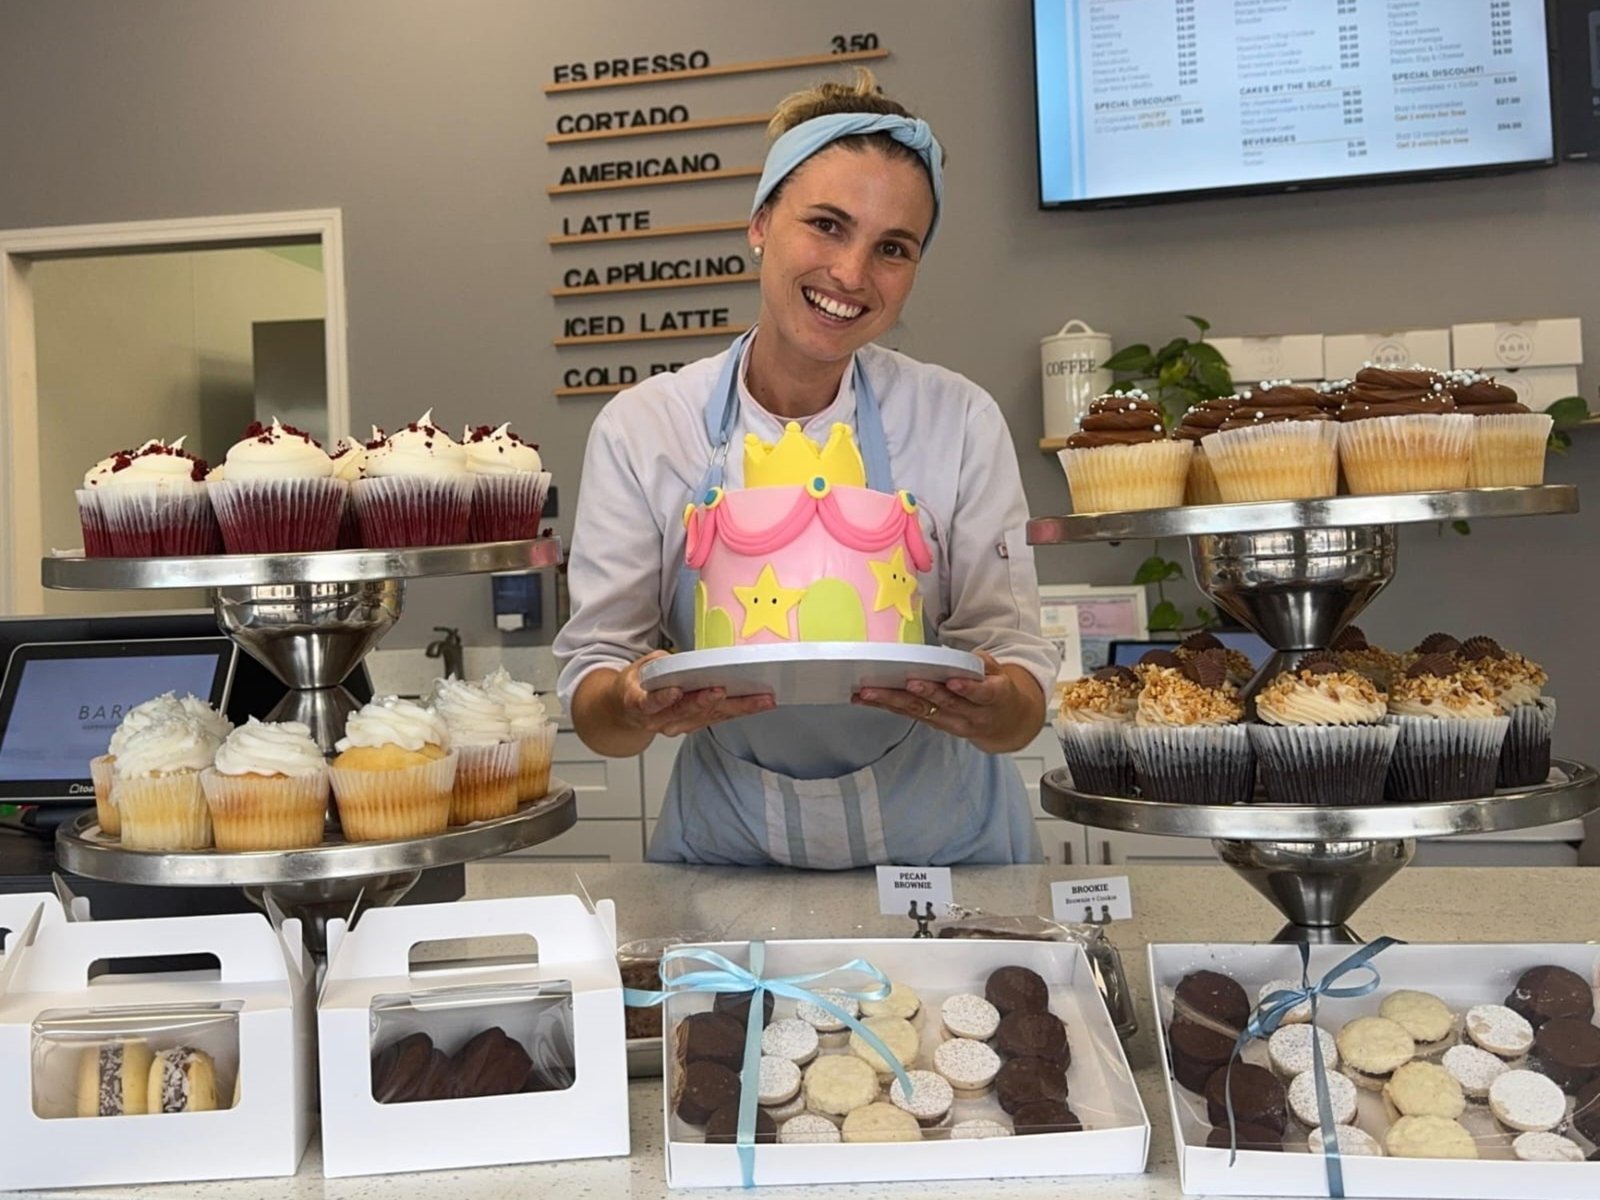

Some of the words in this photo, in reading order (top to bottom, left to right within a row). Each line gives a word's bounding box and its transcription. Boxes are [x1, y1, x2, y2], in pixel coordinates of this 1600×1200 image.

[556, 105, 689, 134] CORTADO
[560, 153, 720, 186] AMERICANO
[564, 211, 650, 236] LATTE
[564, 316, 624, 338] ICED
[641, 308, 728, 332] LATTE
[564, 366, 637, 388] COLD
[1046, 359, 1097, 377] COFFEE
[894, 882, 932, 890] BROWNIE
[899, 872, 927, 880] PECAN
[1072, 884, 1109, 894] BROOKIE
